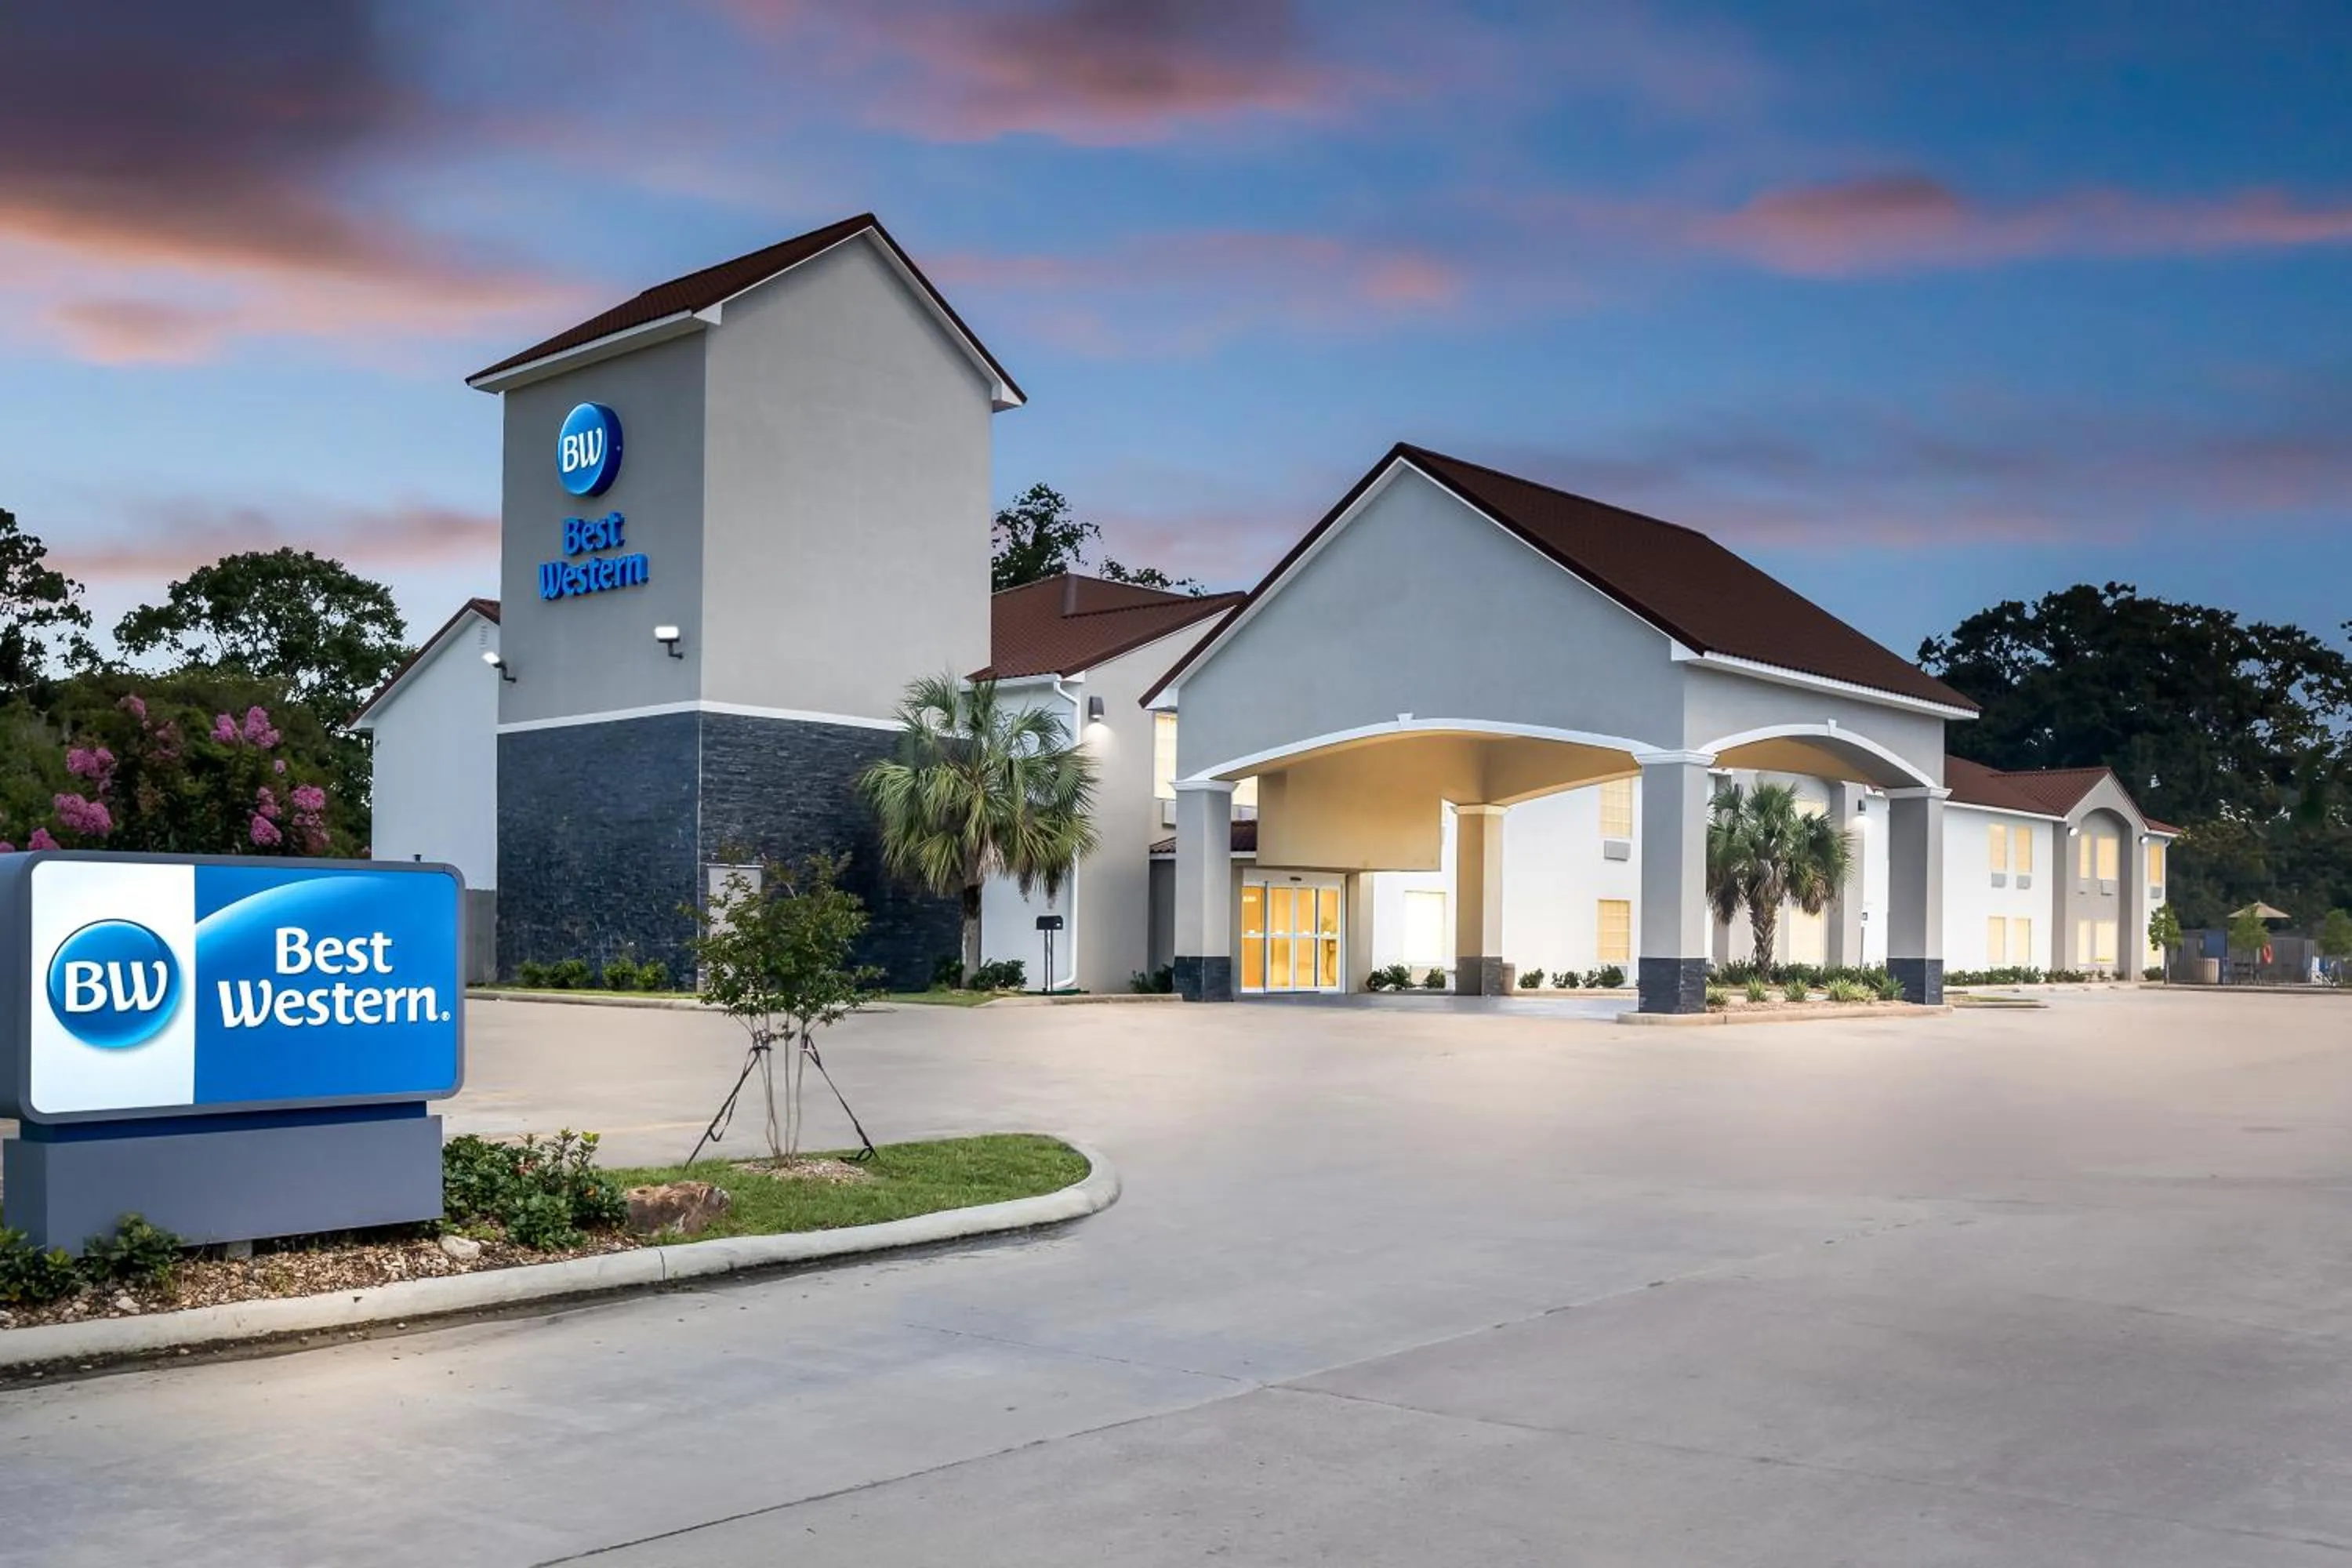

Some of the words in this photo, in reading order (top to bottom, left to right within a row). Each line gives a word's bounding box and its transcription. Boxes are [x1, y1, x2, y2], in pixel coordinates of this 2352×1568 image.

[562, 427, 602, 473] BW
[562, 511, 625, 556] Best
[539, 552, 648, 601] Western
[275, 927, 393, 975] Best
[64, 960, 168, 1013] BW
